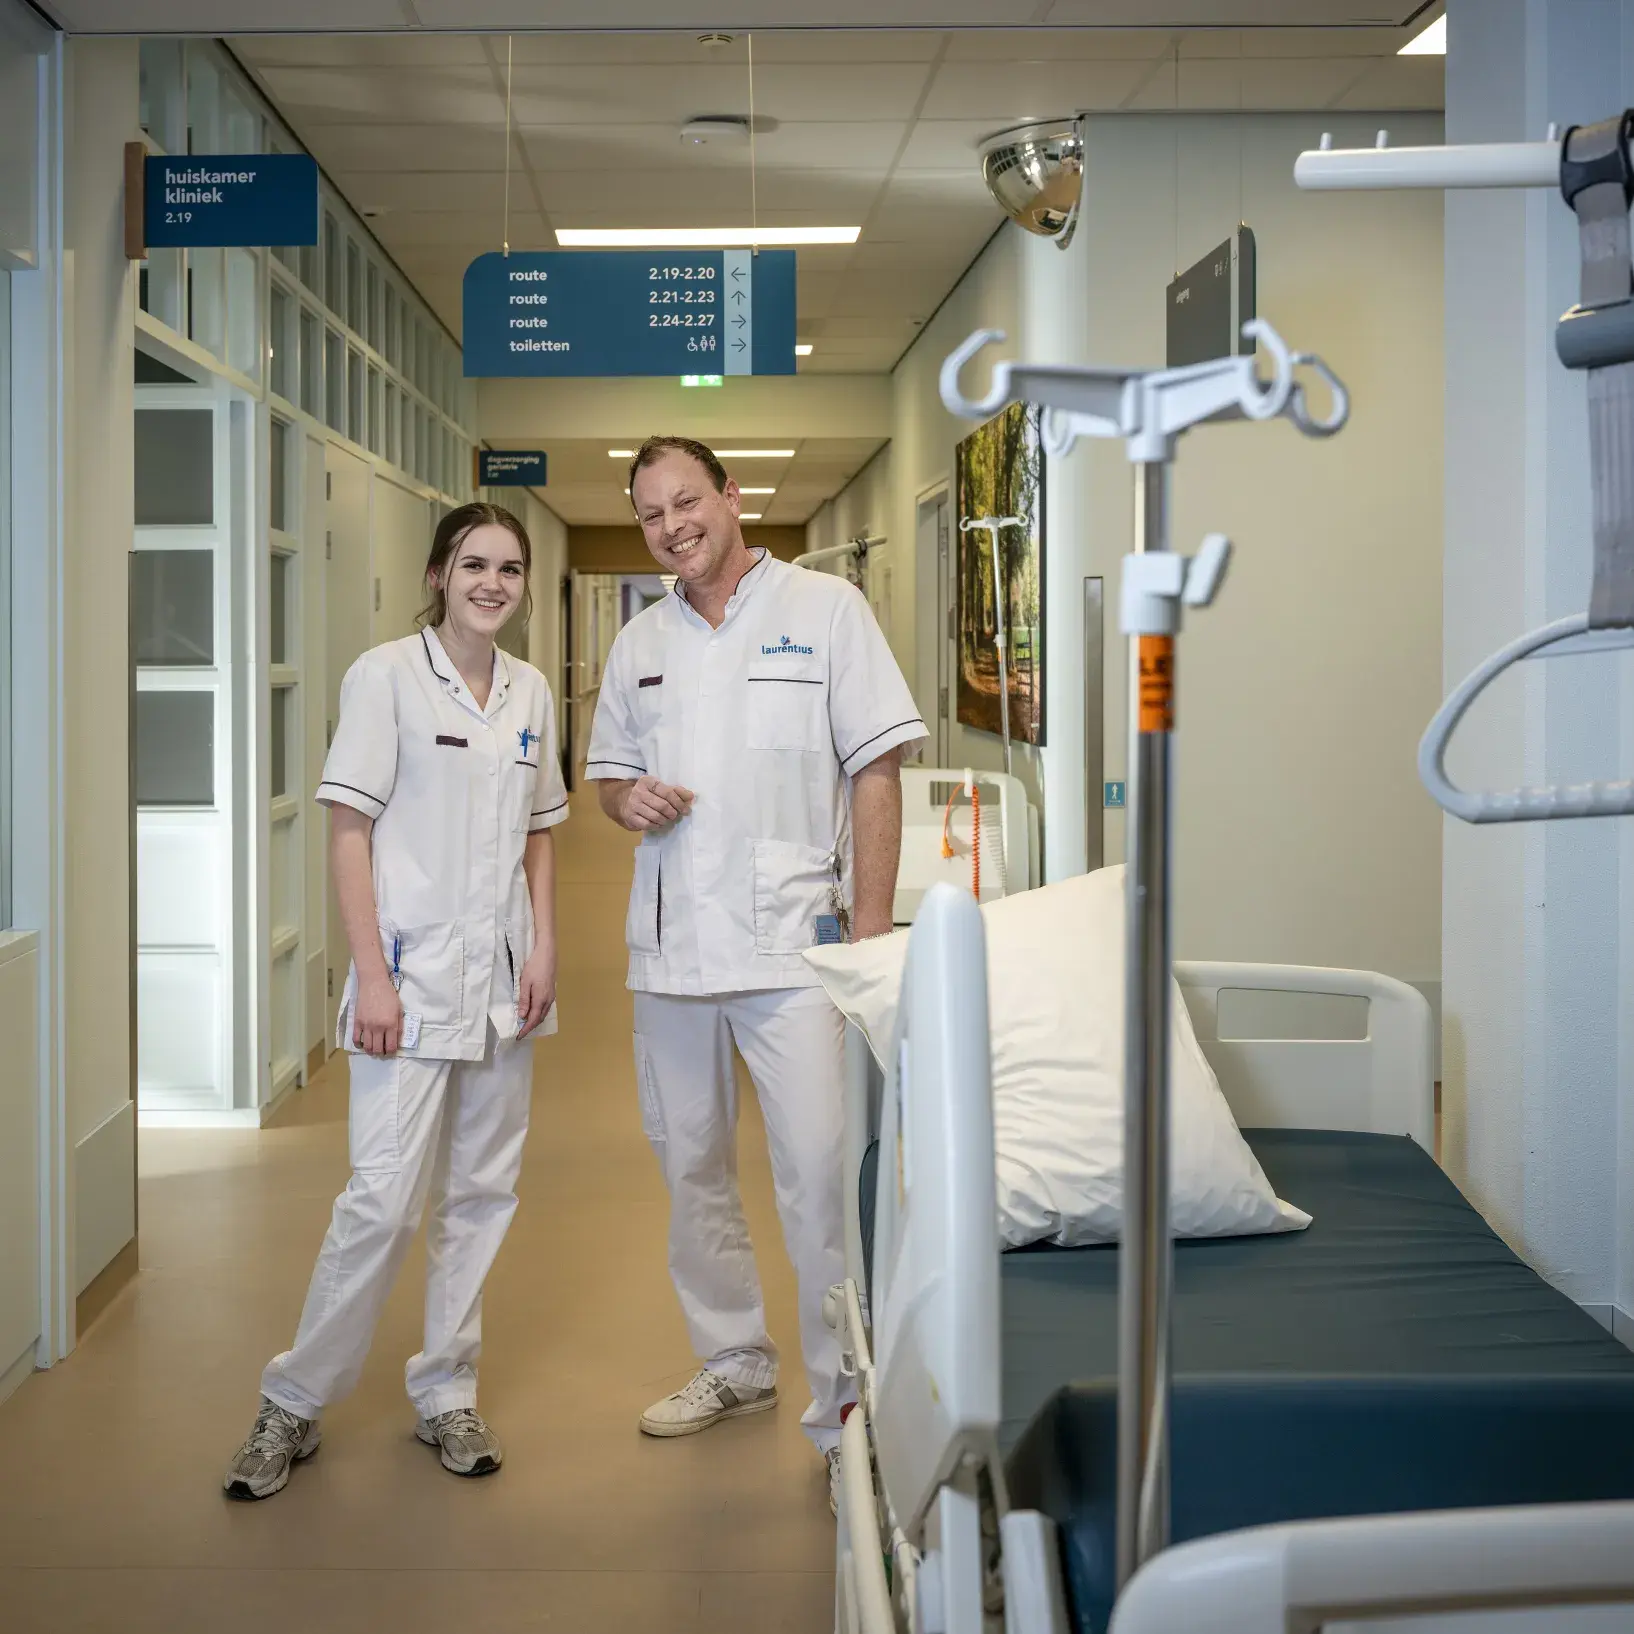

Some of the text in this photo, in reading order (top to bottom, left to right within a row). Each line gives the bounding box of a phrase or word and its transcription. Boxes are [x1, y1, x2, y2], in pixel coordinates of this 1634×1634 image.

[165, 168, 256, 184] huiskamer
[165, 187, 223, 203] kliniek
[165, 212, 192, 223] 2.19
[509, 267, 715, 281] route 2.19-2.20
[509, 291, 715, 305] route 2.21-2.23
[509, 314, 715, 328] route 2.24-2.27
[509, 339, 570, 351] toiletten
[762, 644, 813, 655] laurentius
